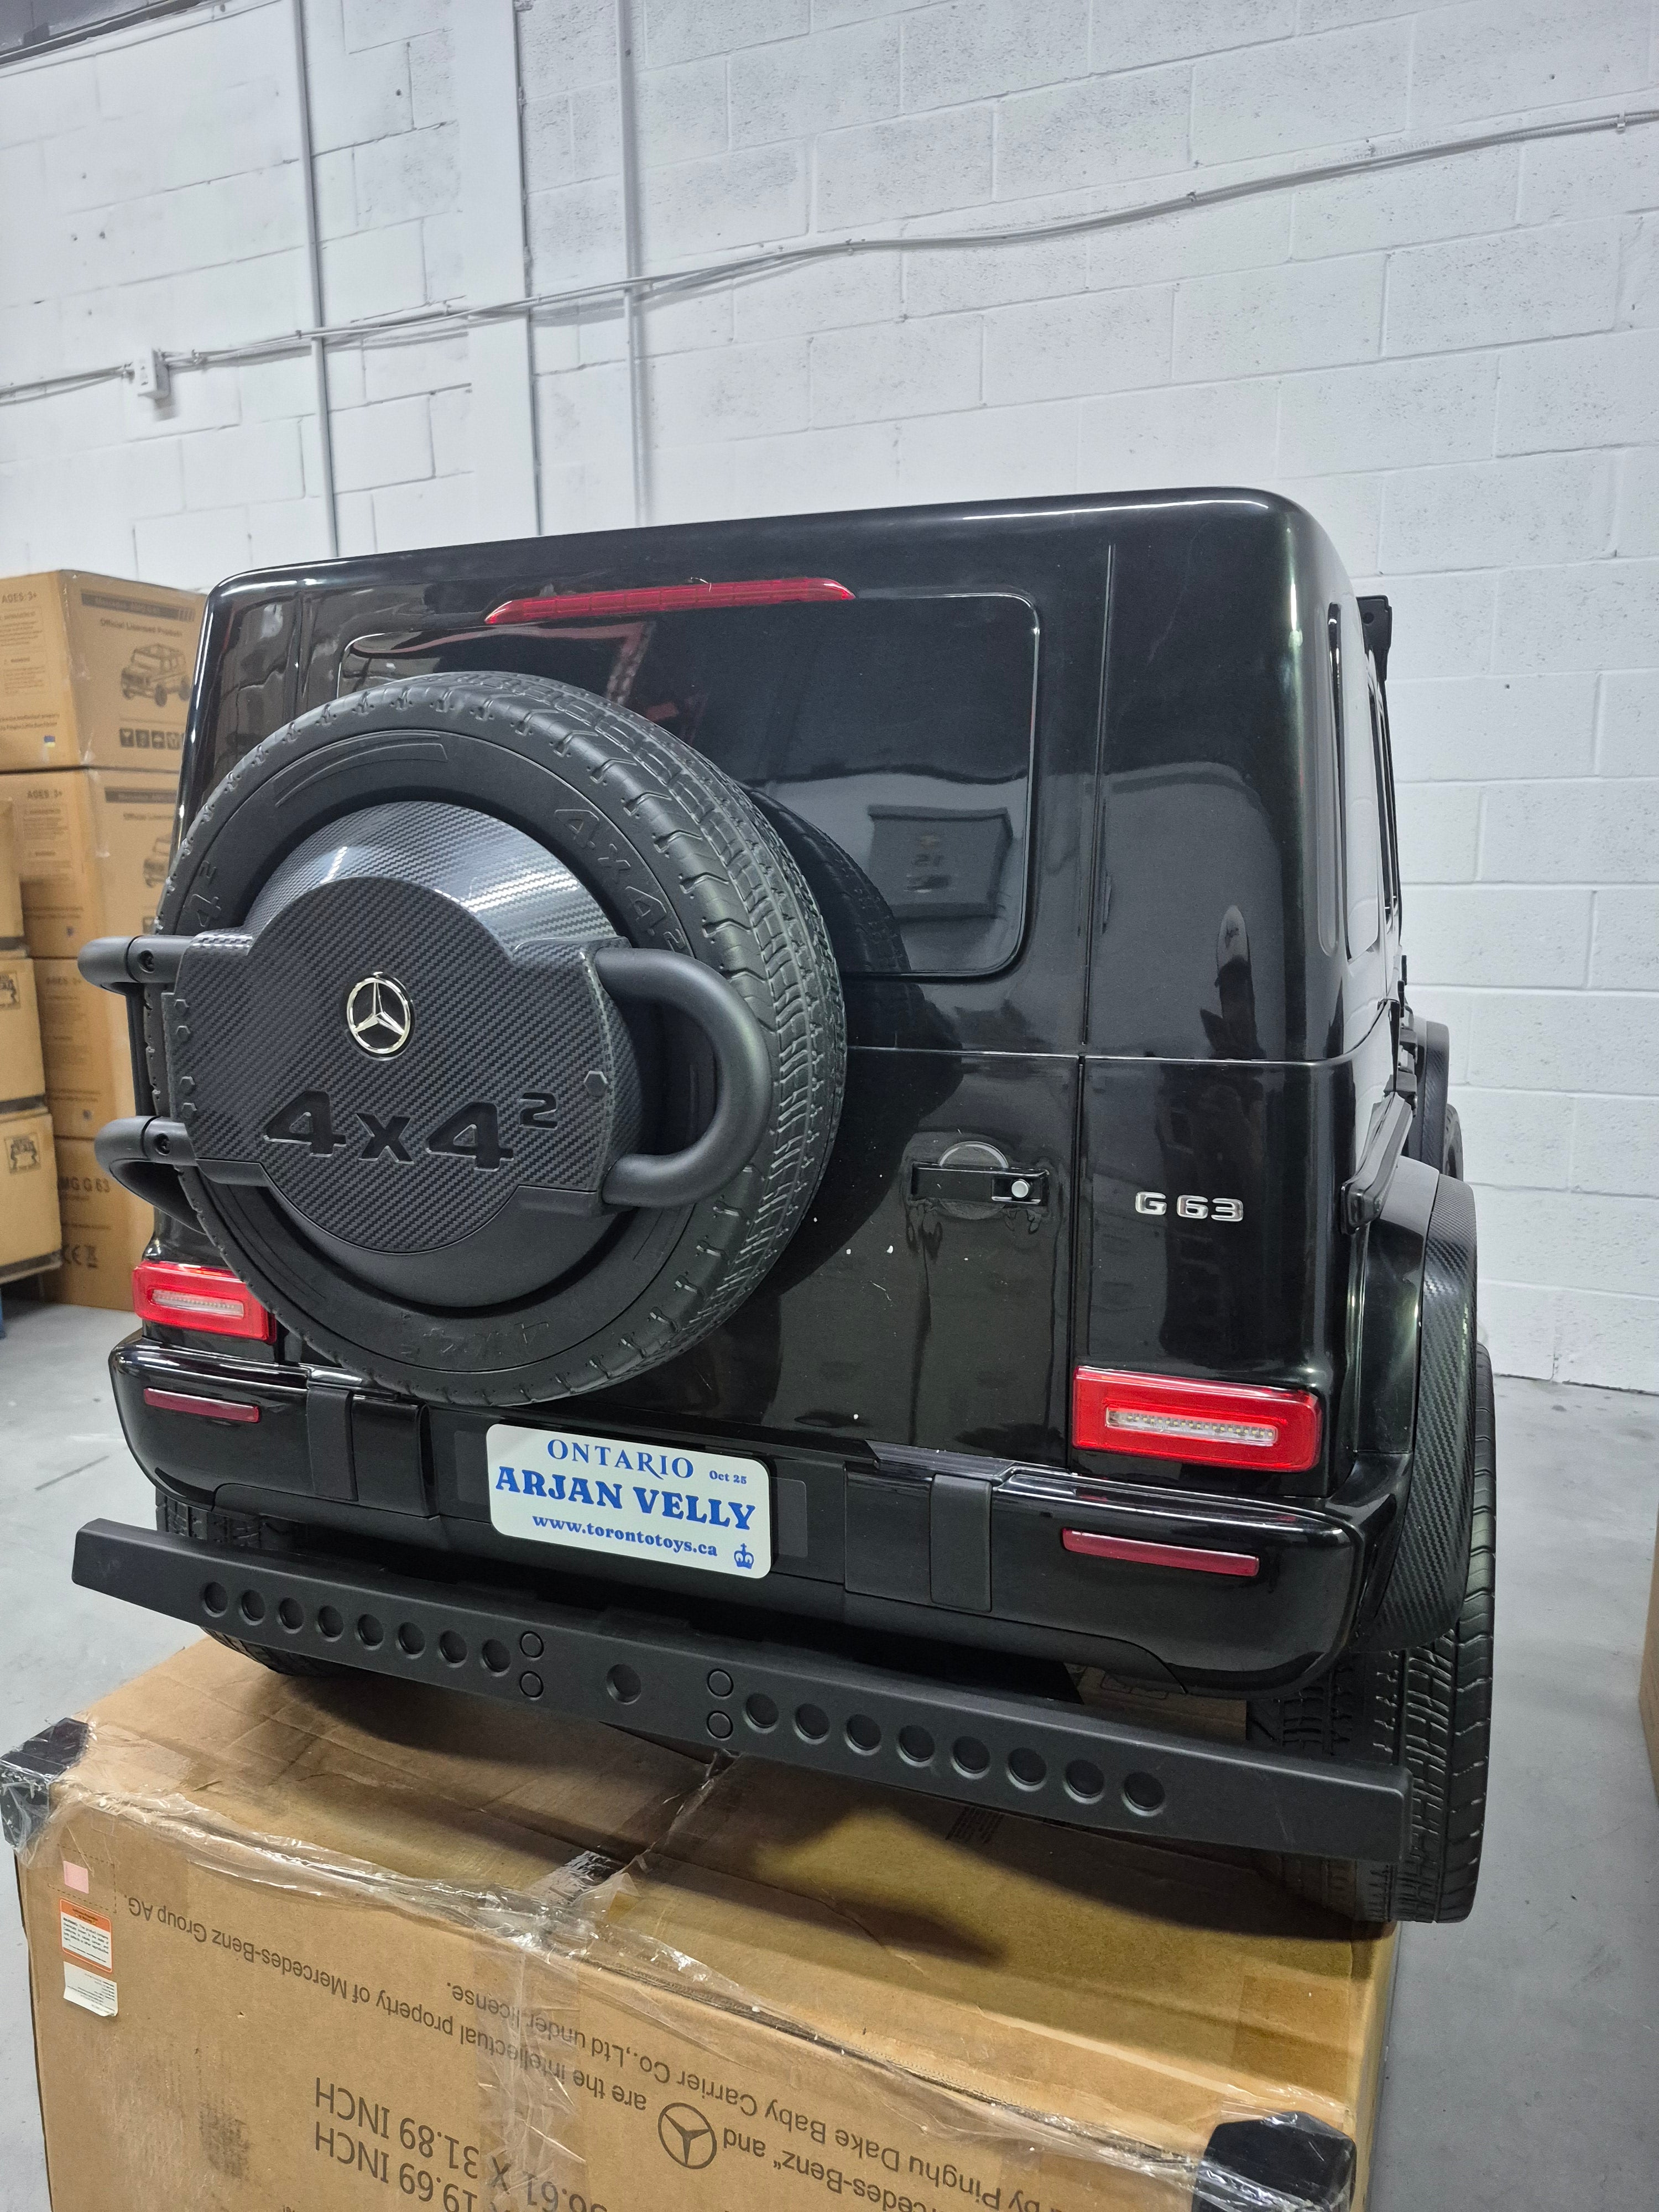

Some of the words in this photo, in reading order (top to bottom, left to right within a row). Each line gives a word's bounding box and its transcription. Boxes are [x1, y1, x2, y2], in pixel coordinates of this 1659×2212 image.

[1135, 1191, 1167, 1215] G
[1176, 1194, 1244, 1222] 63
[547, 1439, 694, 1480] ONTARIO
[709, 1470, 729, 1482] Oct
[495, 1466, 623, 1509] ARJAN
[633, 1486, 756, 1530] VELLY
[532, 1516, 718, 1557] www.torontotoys.ca
[124, 1895, 153, 1921] AG.
[158, 1905, 207, 1942] Group
[211, 1929, 347, 1999] Mercedes-Benz
[352, 1984, 371, 2004] of
[375, 1990, 453, 2036] property
[447, 1981, 520, 2028] license.
[526, 2012, 586, 2047] under
[460, 2025, 565, 2085] intellectual
[573, 2069, 606, 2099] the
[612, 2085, 647, 2110] are
[676, 2070, 758, 2116] Carrier
[315, 2077, 390, 2140] INCH
[765, 2099, 826, 2145] Baby
[315, 2121, 389, 2184] INCH
[399, 2117, 479, 2179] 31.89
[723, 2127, 766, 2157] and
[834, 2129, 900, 2172] Dake
[398, 2163, 478, 2212] 19.69
[909, 2156, 1001, 2209] Pinghu
